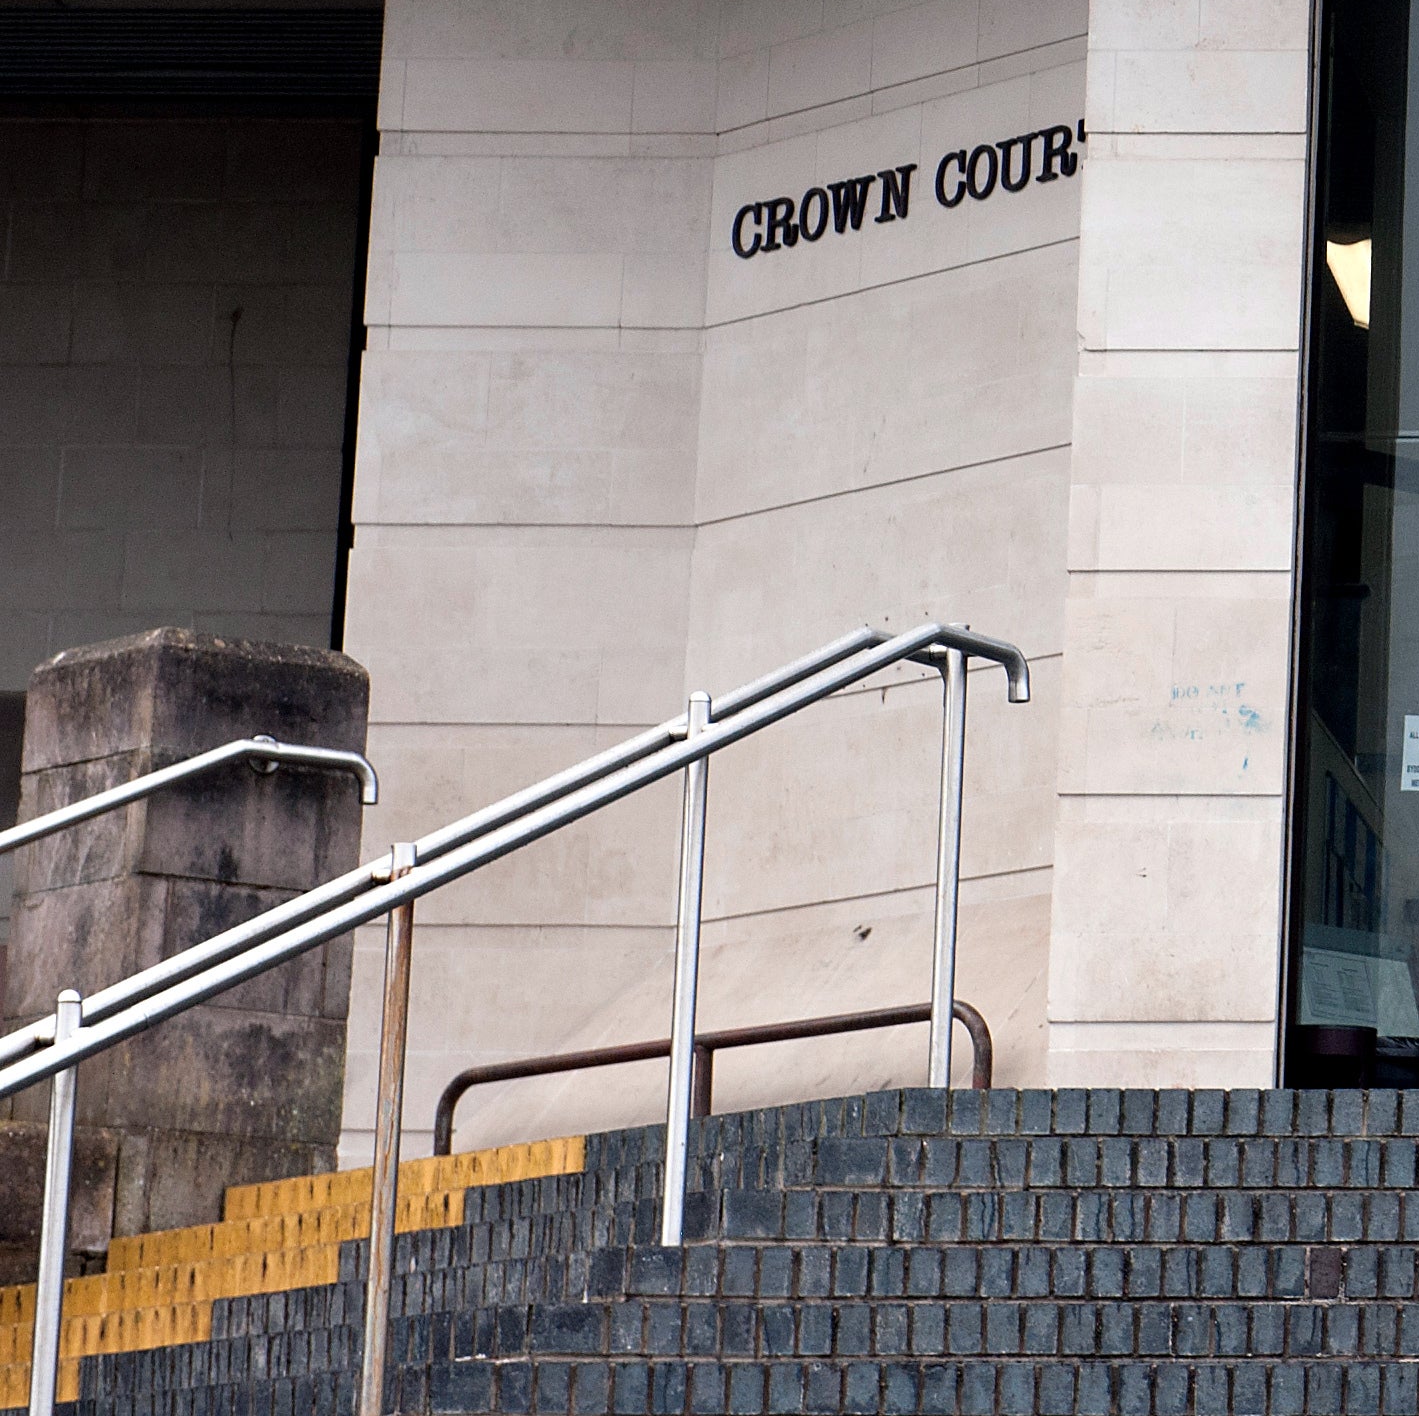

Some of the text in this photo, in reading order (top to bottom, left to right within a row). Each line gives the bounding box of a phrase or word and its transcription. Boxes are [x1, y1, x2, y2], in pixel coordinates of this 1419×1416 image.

[732, 118, 1086, 259] CROWN COUR
[1409, 732, 1419, 740] ALL
